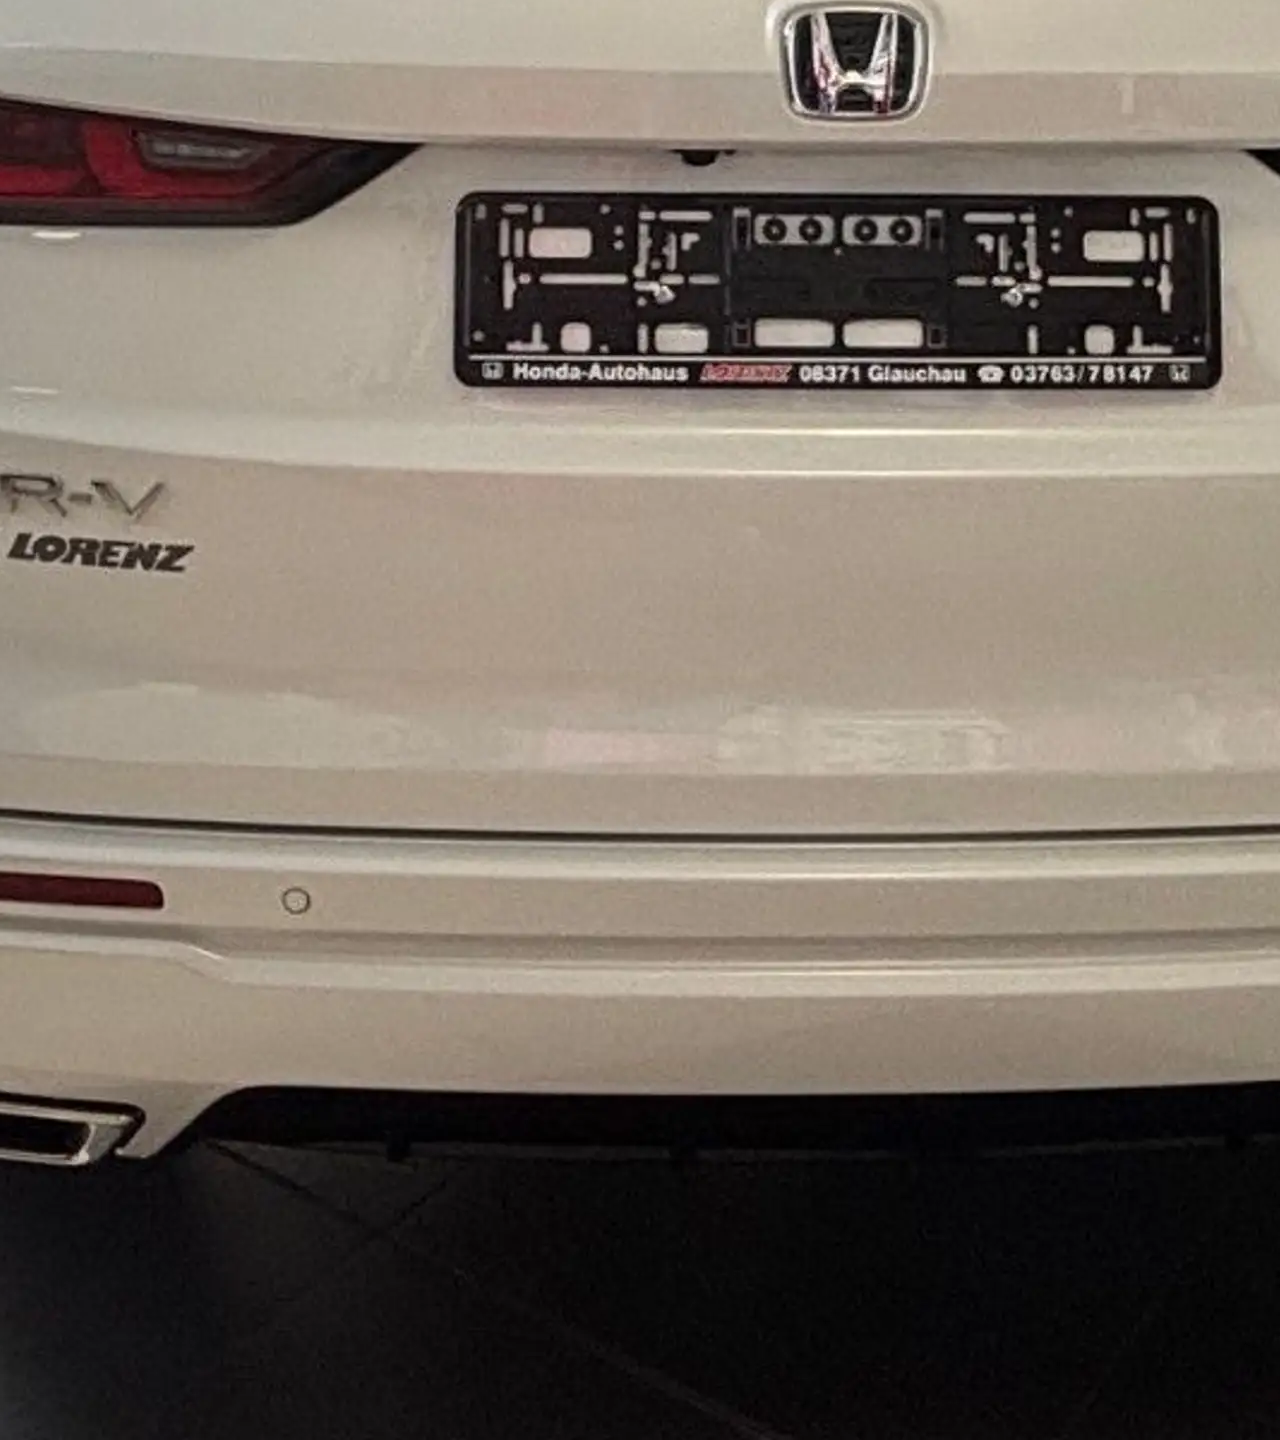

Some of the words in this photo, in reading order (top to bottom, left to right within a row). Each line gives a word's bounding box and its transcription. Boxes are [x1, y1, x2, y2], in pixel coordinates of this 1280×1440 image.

[512, 363, 689, 382] Honda-Autohaus
[798, 364, 860, 383] 08371
[868, 364, 967, 383] Glauchau
[7, 532, 195, 573] LORENZ
